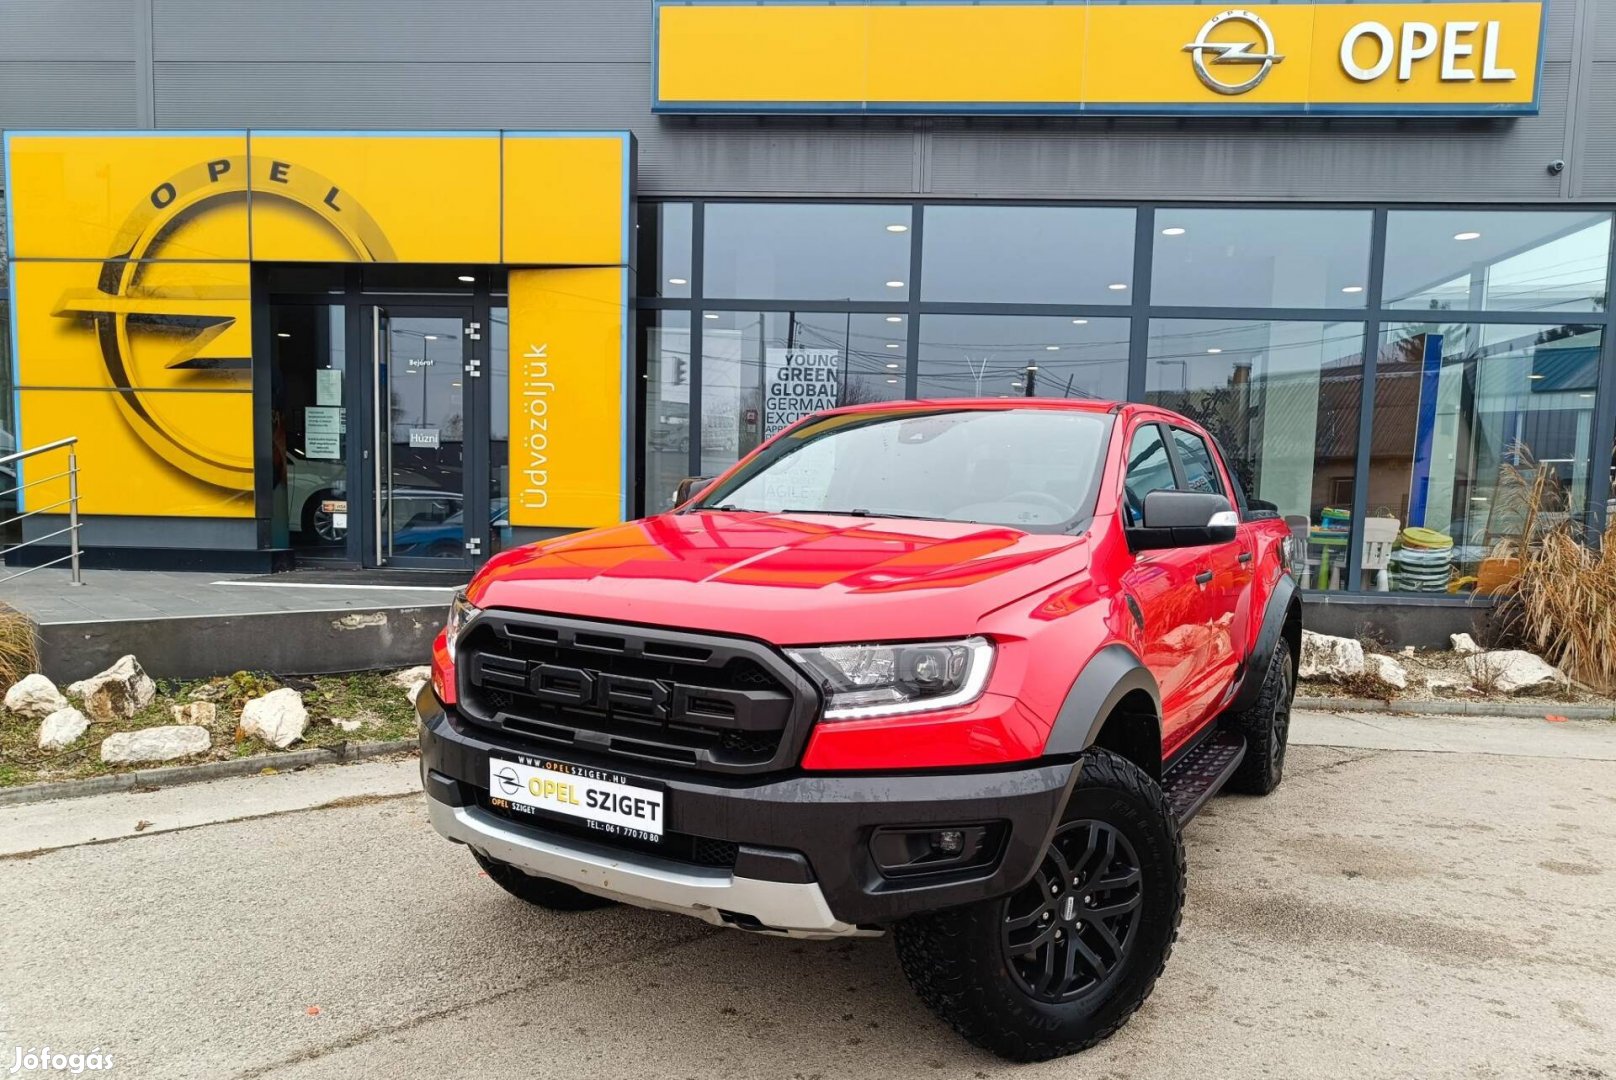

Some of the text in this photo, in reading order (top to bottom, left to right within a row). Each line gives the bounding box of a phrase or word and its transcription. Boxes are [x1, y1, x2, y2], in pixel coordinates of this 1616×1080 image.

[1212, 10, 1261, 23] OPEL
[1340, 21, 1517, 81] OPEL
[150, 159, 342, 212] OPEL
[777, 367, 839, 382] GREEN
[785, 354, 838, 367] YOUNG
[771, 383, 839, 397] GLOBAL
[520, 343, 555, 508] Üdvözöljük
[472, 652, 775, 730] FORD
[518, 756, 627, 785] WWW.OPELSZIGET.HU
[491, 797, 536, 815] OPEL SZIGET
[528, 777, 661, 822] OPEL SZIGET
